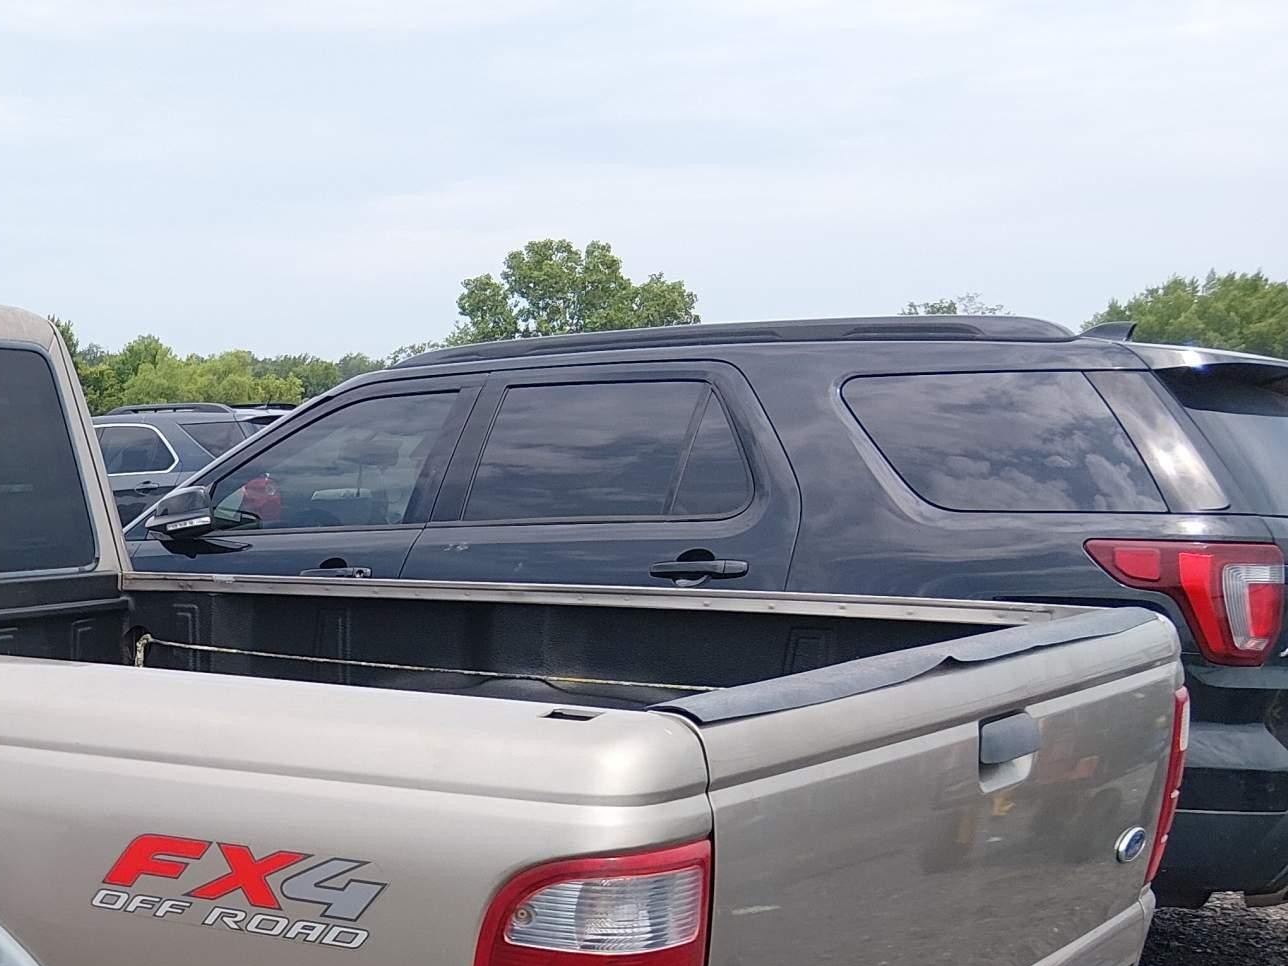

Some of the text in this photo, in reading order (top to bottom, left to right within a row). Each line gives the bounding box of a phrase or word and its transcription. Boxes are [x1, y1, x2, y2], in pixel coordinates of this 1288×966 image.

[102, 833, 389, 922] FX4
[91, 888, 370, 950] OFF ROAD
